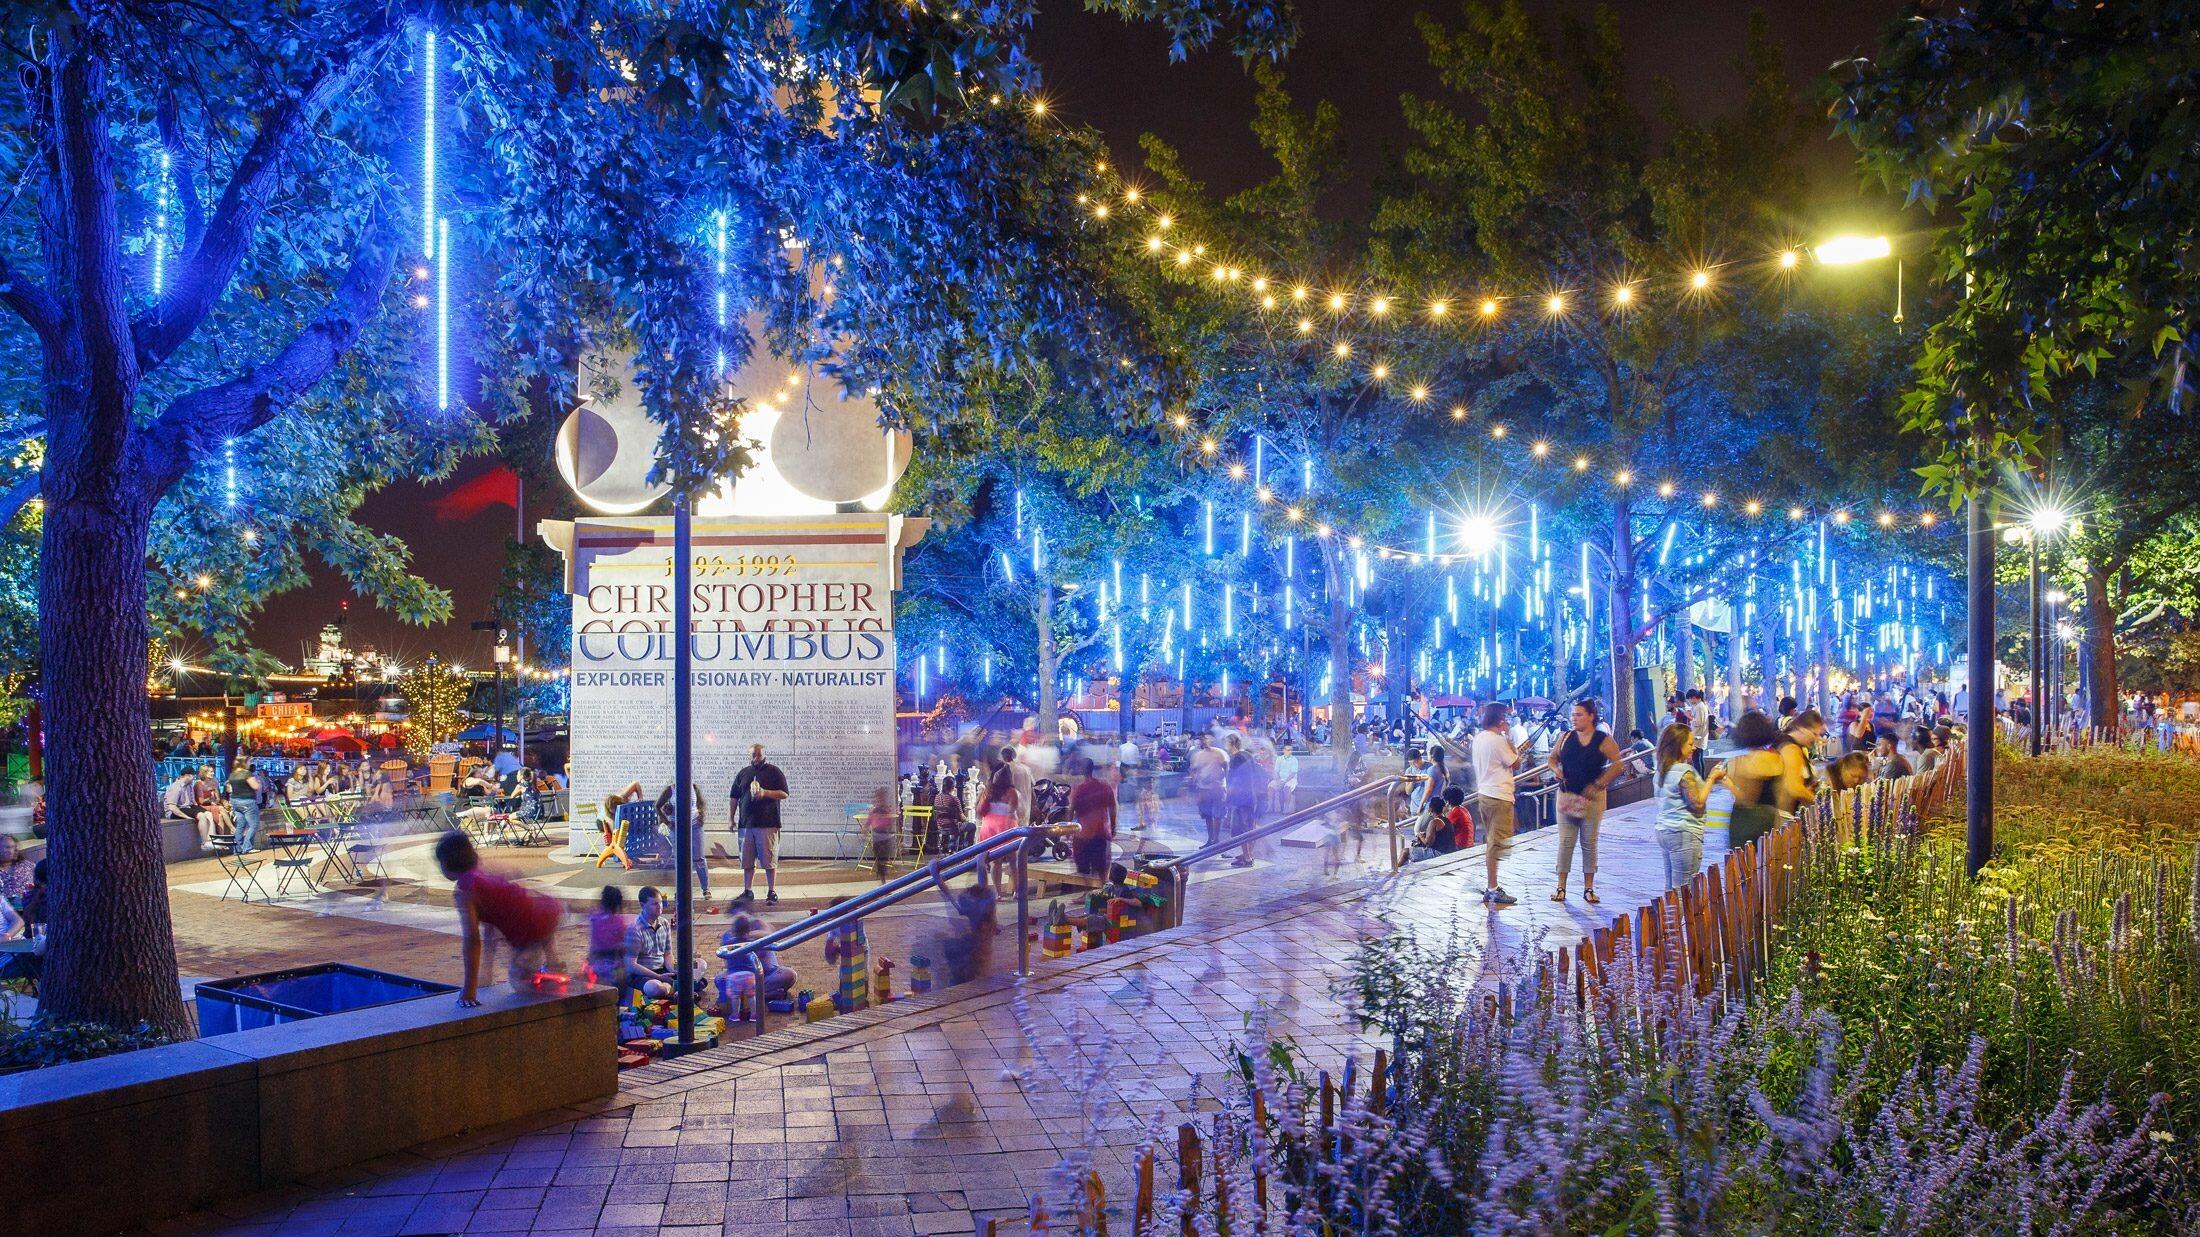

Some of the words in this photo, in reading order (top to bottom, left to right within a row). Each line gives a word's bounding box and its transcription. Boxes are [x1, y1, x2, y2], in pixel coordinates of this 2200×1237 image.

[587, 582, 877, 614] CHRSTOPHER
[576, 672, 665, 687] EXPLORER
[690, 672, 772, 687] ISIONARY
[782, 671, 887, 687] NATURALIST
[272, 705, 299, 715] CHIFA
